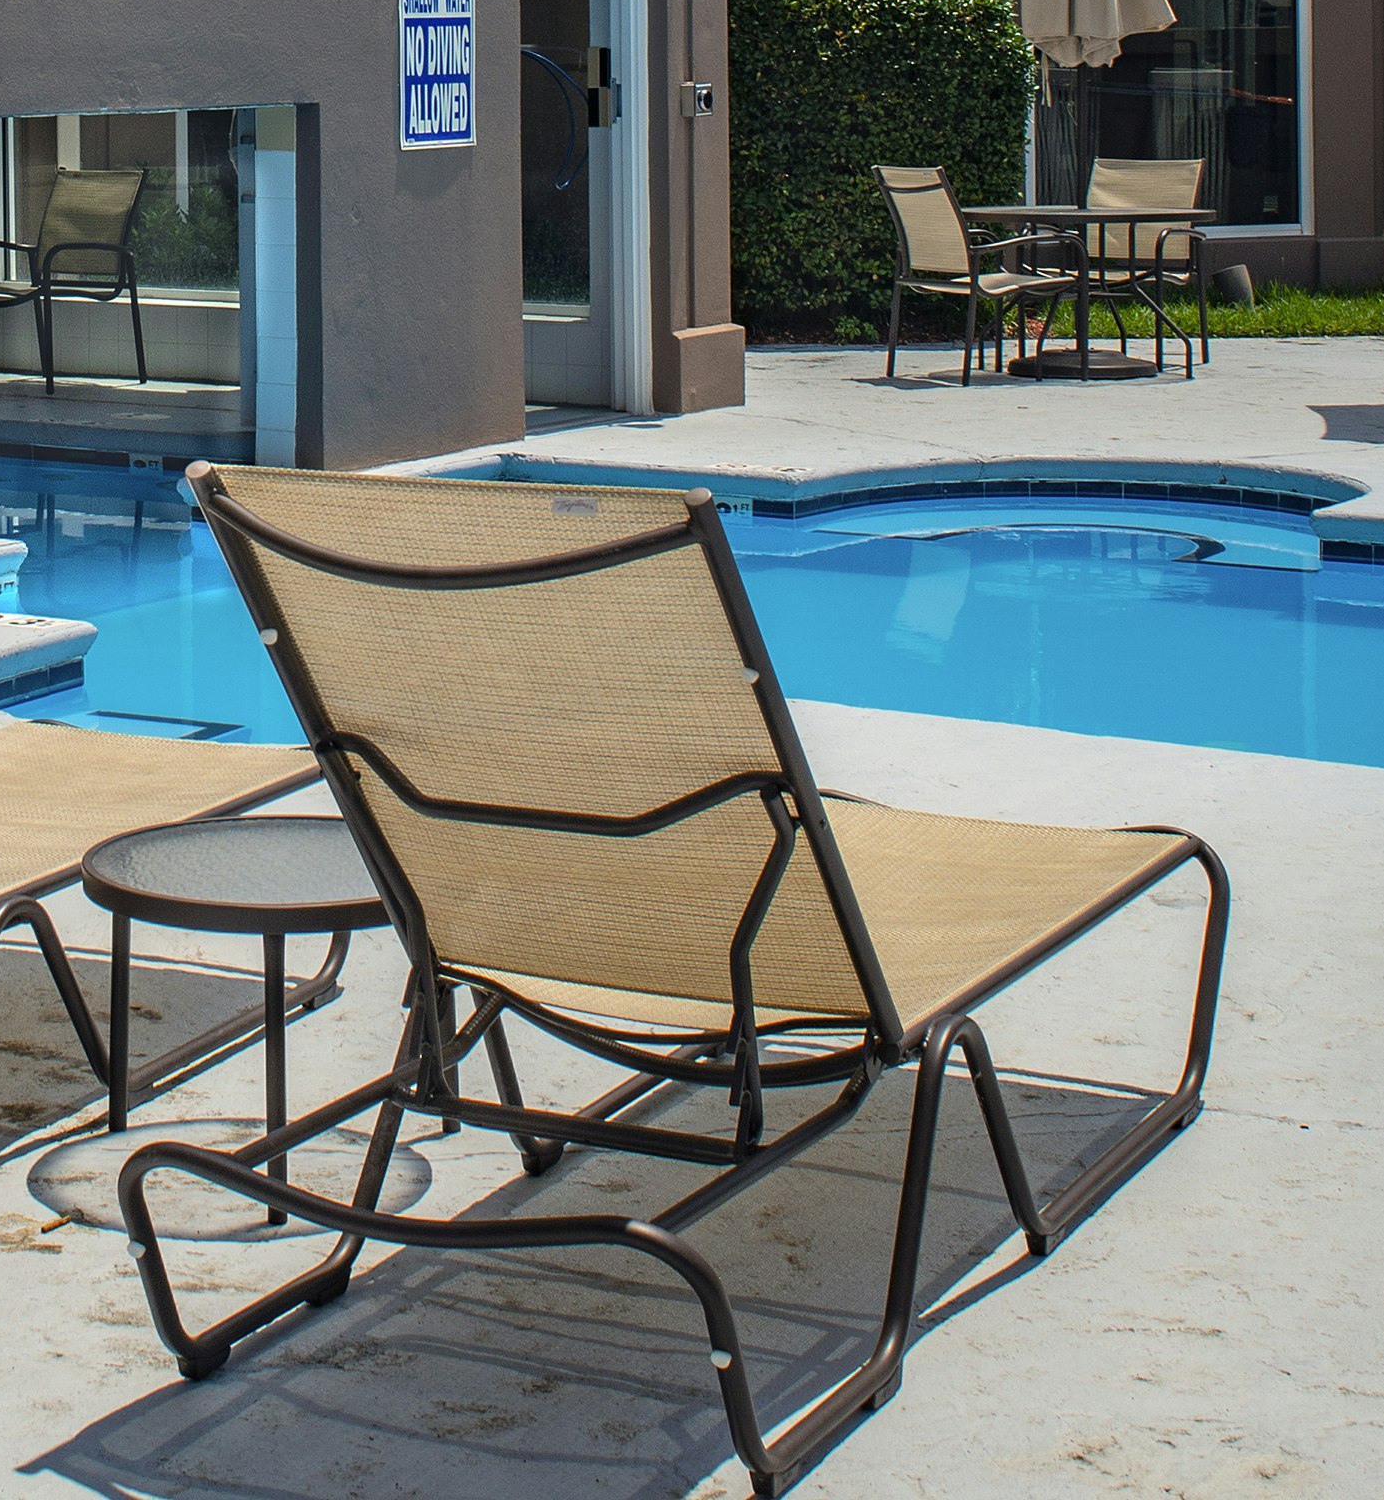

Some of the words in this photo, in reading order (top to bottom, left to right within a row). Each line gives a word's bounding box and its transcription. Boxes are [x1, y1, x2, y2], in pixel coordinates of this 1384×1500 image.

[406, 25, 425, 77] NO
[428, 24, 469, 76] DIVING
[409, 83, 468, 134] ALLOWED
